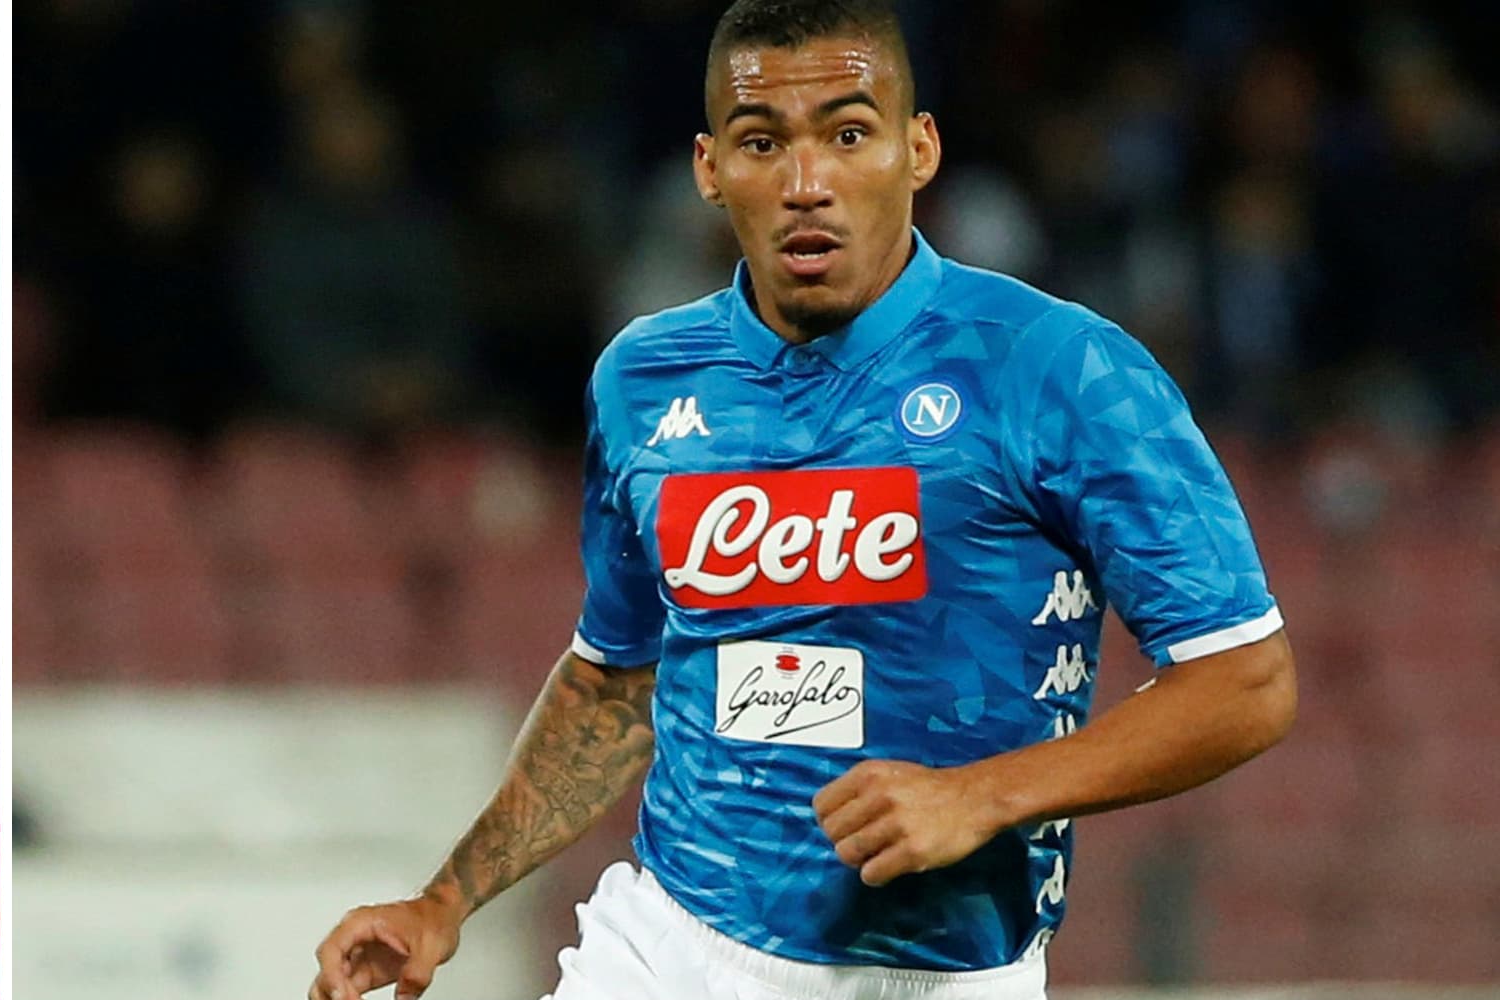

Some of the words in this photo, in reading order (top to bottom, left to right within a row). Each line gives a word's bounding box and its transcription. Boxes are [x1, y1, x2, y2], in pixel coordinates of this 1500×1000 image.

[911, 391, 948, 427] N
[664, 485, 919, 596] Lete
[716, 660, 861, 740] Garofalo
